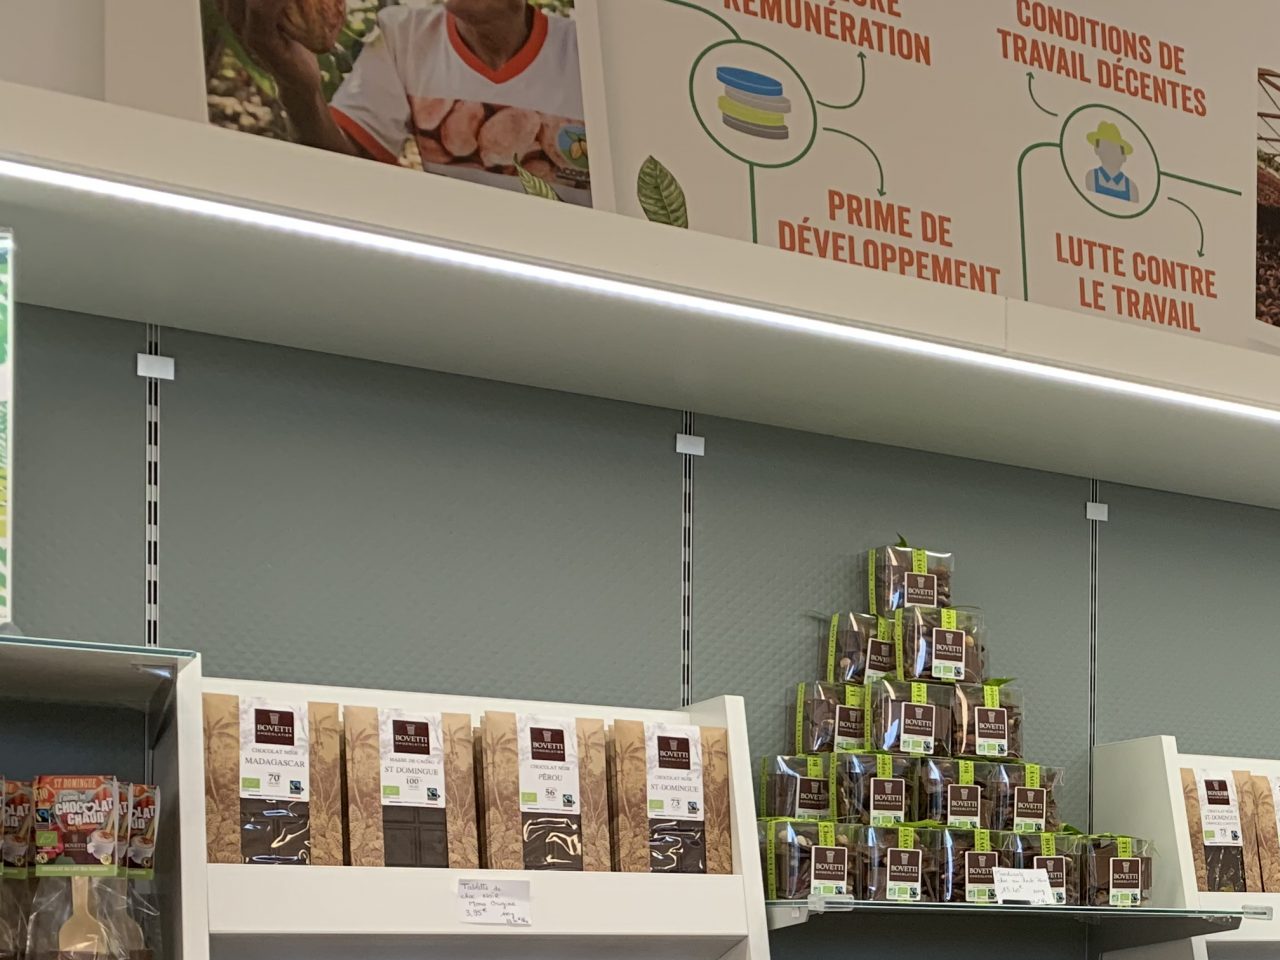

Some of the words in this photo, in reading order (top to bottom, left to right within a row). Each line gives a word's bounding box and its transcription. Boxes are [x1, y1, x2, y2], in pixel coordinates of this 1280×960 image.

[1016, 0, 1152, 65] CONDITIONS
[1158, 40, 1187, 76] DE
[996, 27, 1092, 84] TRAVAIL
[1096, 57, 1208, 118] DÉCENTES
[828, 188, 913, 239] PRIME
[920, 210, 953, 248] DE
[778, 216, 1001, 295] DÉVELOPPEMENT
[1055, 232, 1126, 278] LUTTE
[1132, 251, 1218, 300] CONTRE
[1079, 276, 1106, 312] LE
[1111, 284, 1201, 333] TRAVAIL
[908, 587, 934, 596] BOVETTI
[936, 643, 962, 652] BOVETTI
[905, 718, 932, 728] BOVETTI
[979, 722, 1005, 731] BOVETTI
[257, 724, 292, 733] BOVETTI
[395, 735, 428, 743] BOVETTI
[245, 757, 305, 767] MADAGASCAR
[396, 767, 438, 775] DOMINGUE
[538, 773, 563, 781] PÉROU
[1017, 802, 1043, 810] BOVETTI
[67, 812, 105, 826] CHAUD
[816, 863, 844, 871] BOVETTI
[891, 865, 918, 873] BOVETTI
